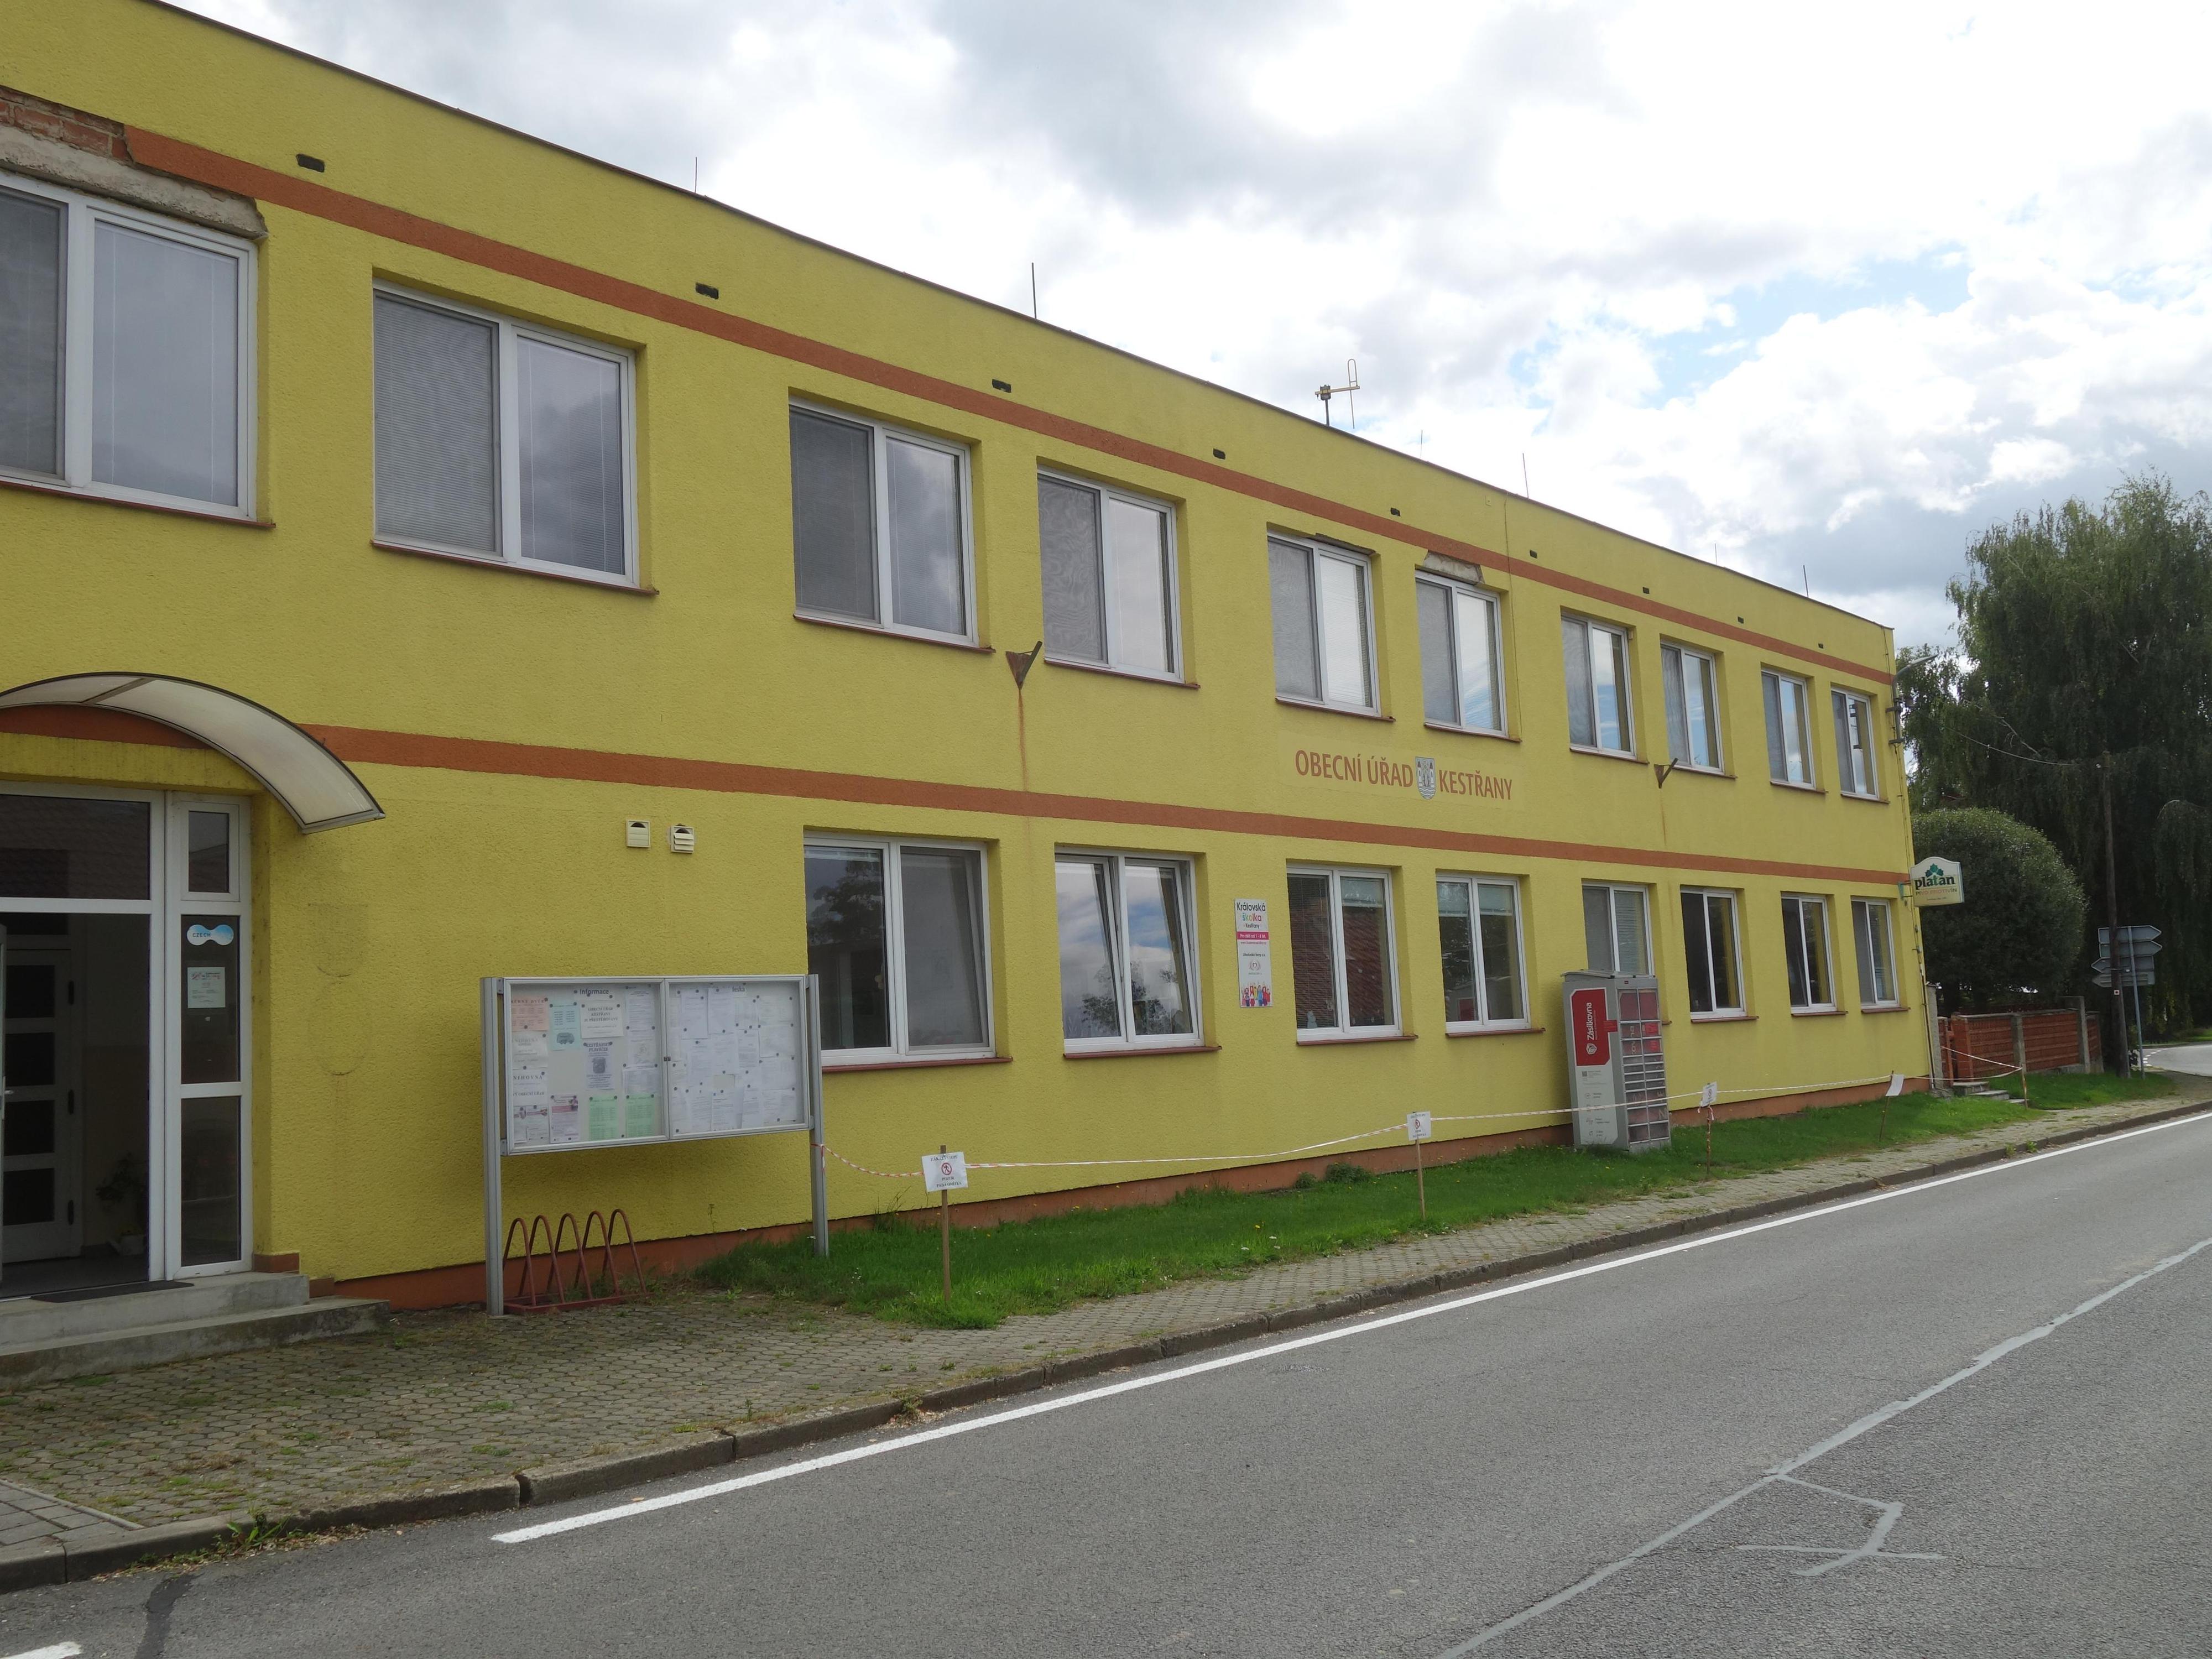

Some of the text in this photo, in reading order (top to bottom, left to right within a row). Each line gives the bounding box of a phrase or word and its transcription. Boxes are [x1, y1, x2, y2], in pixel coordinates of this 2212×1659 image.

[1295, 749, 1512, 800] OBECNÍ ÚŘAD KESTŘANY
[1914, 875, 1955, 890] platan
[1237, 902, 1266, 911] Královská
[1243, 912, 1261, 921] školka
[1586, 1002, 1594, 1040] Zásilkovna
